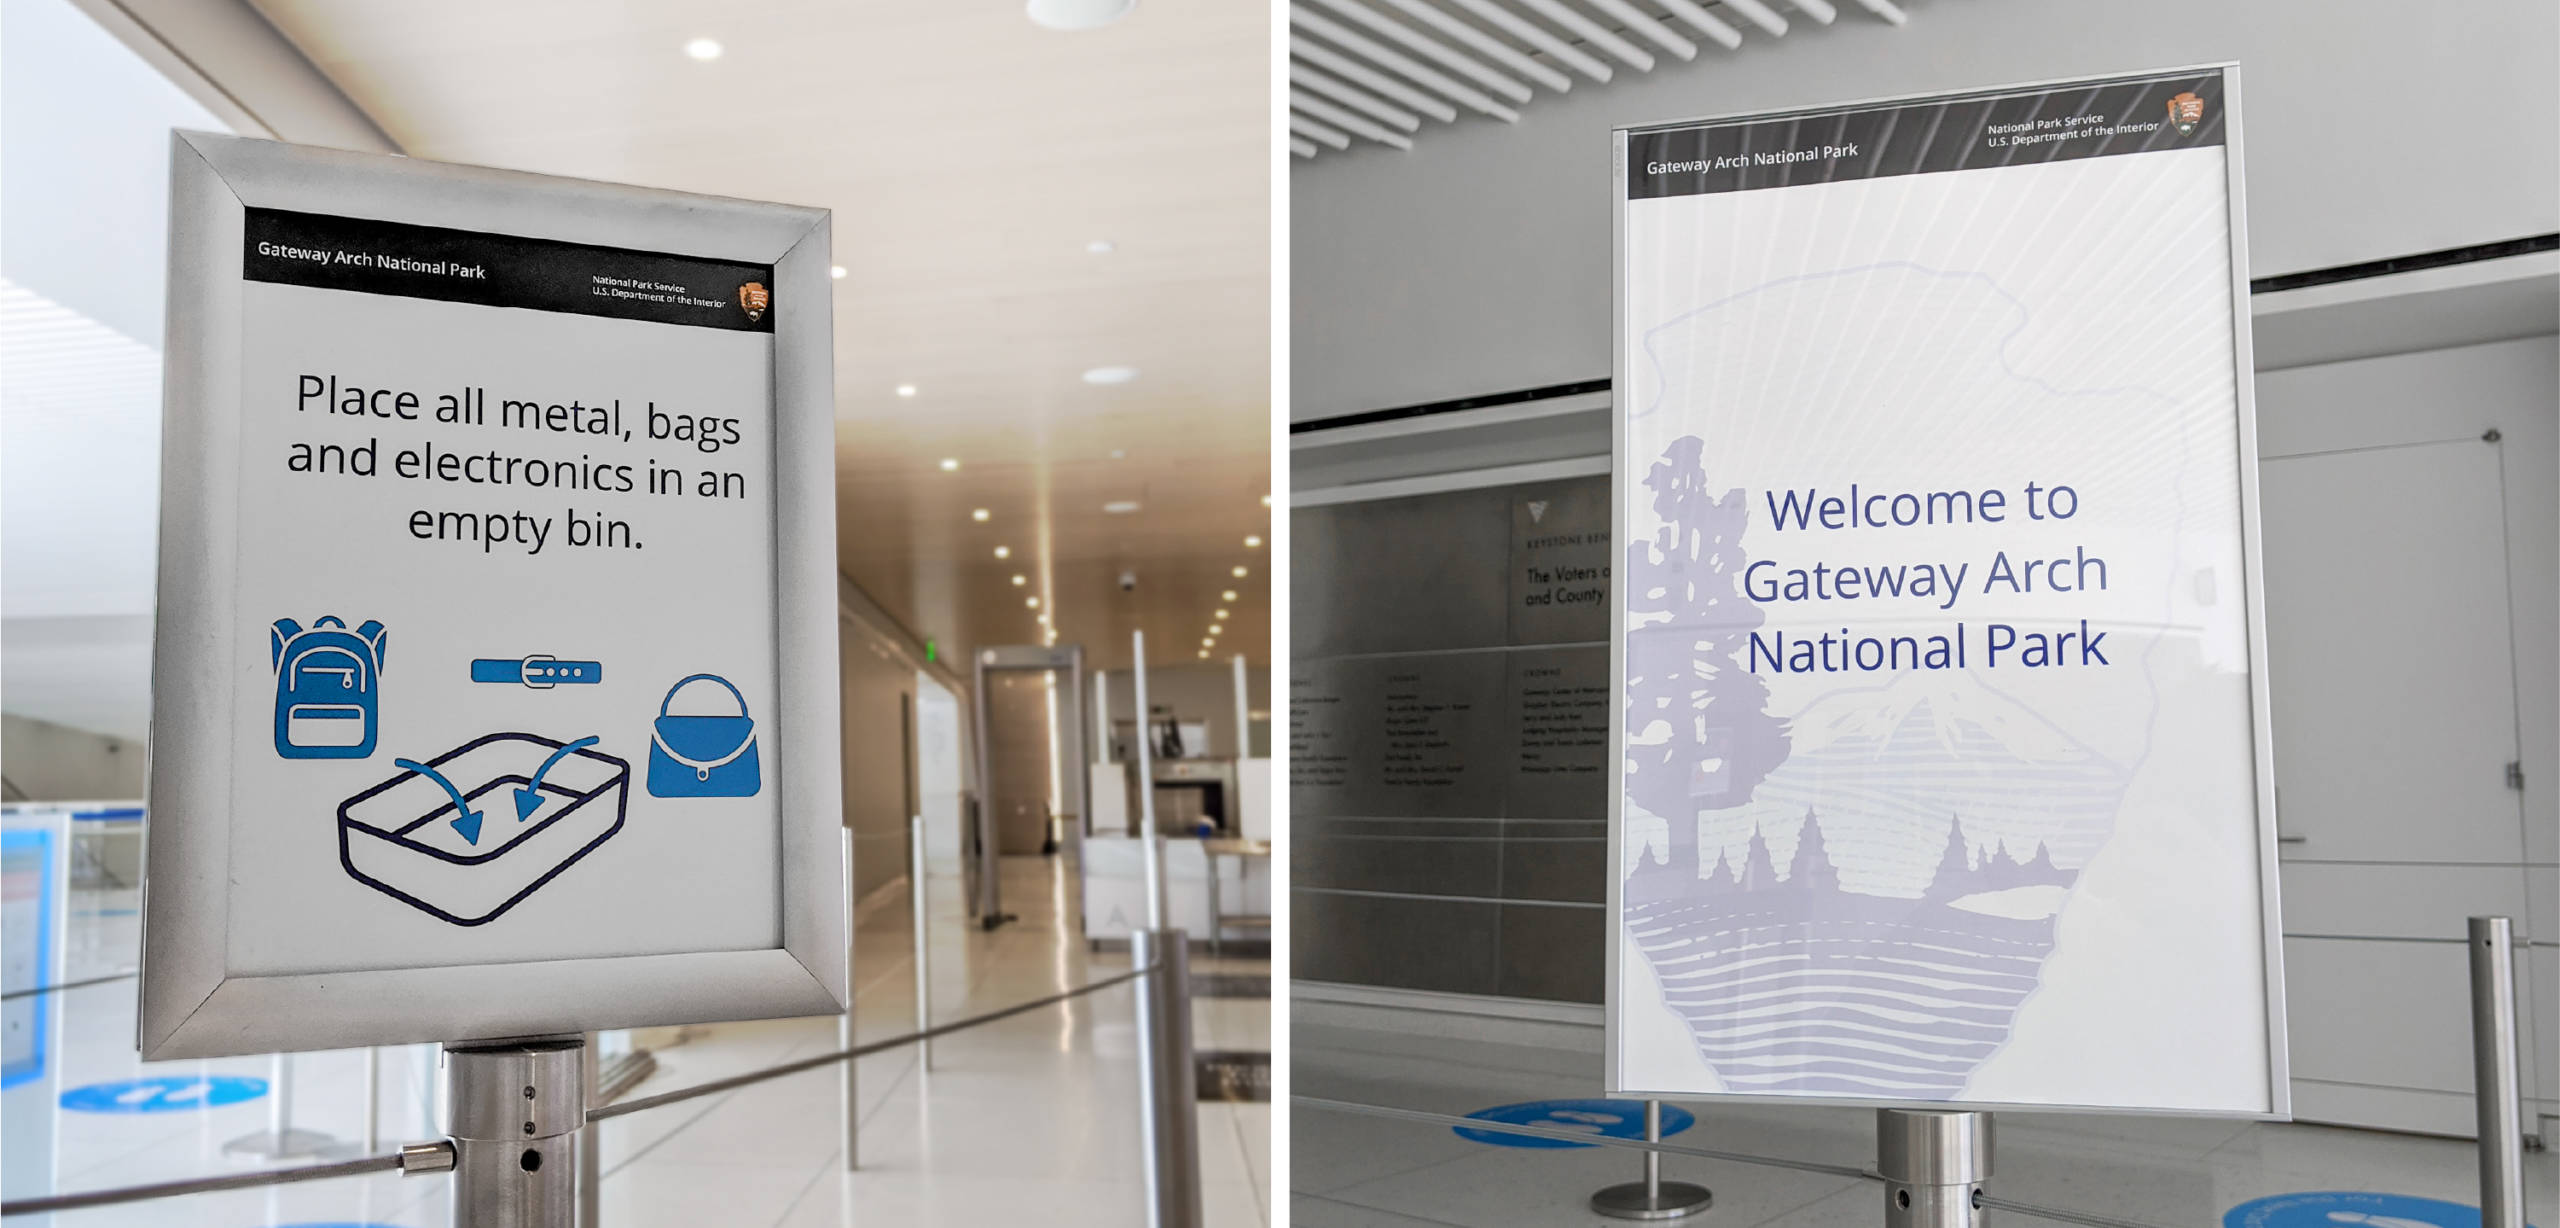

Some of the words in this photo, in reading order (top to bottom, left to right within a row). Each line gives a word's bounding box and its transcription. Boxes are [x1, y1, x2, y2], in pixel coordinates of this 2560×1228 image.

[1988, 120, 2035, 134] National
[2037, 117, 2062, 131] Park
[2064, 113, 2104, 127] Service
[1988, 136, 2009, 148] U.S.
[2011, 129, 2079, 147] Department
[2080, 127, 2093, 138] of
[2095, 126, 2114, 136] the
[2116, 121, 2160, 135] Interior
[1647, 157, 1712, 176] Gateway
[1715, 151, 1750, 168] Arch
[1754, 146, 1819, 166] National
[1823, 142, 1859, 160] Park
[258, 241, 332, 267] Gateway
[335, 249, 373, 267] Arch
[377, 254, 446, 276] National
[450, 262, 486, 280] Park
[592, 275, 631, 289] National
[632, 279, 653, 291] Park
[653, 281, 686, 293] Service
[592, 286, 610, 297] U.S.
[611, 288, 665, 303] Department
[666, 293, 677, 303] of
[678, 295, 692, 305] the
[693, 297, 727, 309] Interior
[298, 374, 420, 421] Place
[436, 386, 483, 426] all
[502, 400, 634, 443] metal,
[648, 401, 742, 454] bags
[287, 437, 378, 477] and
[394, 441, 635, 494] electronics
[649, 458, 682, 496] in
[697, 470, 746, 500] an
[1766, 483, 2006, 532] Welcome
[2023, 480, 2078, 521] to
[409, 508, 552, 556] empty
[566, 508, 643, 551] bin.
[1527, 566, 1551, 585] The
[1555, 565, 1598, 583] Voters
[1744, 560, 1969, 612] Gateway
[1983, 545, 2107, 594] Arch
[1525, 588, 1552, 607] and
[1556, 586, 1606, 607] County
[1750, 622, 1965, 674] National
[1987, 618, 2110, 668] Park
